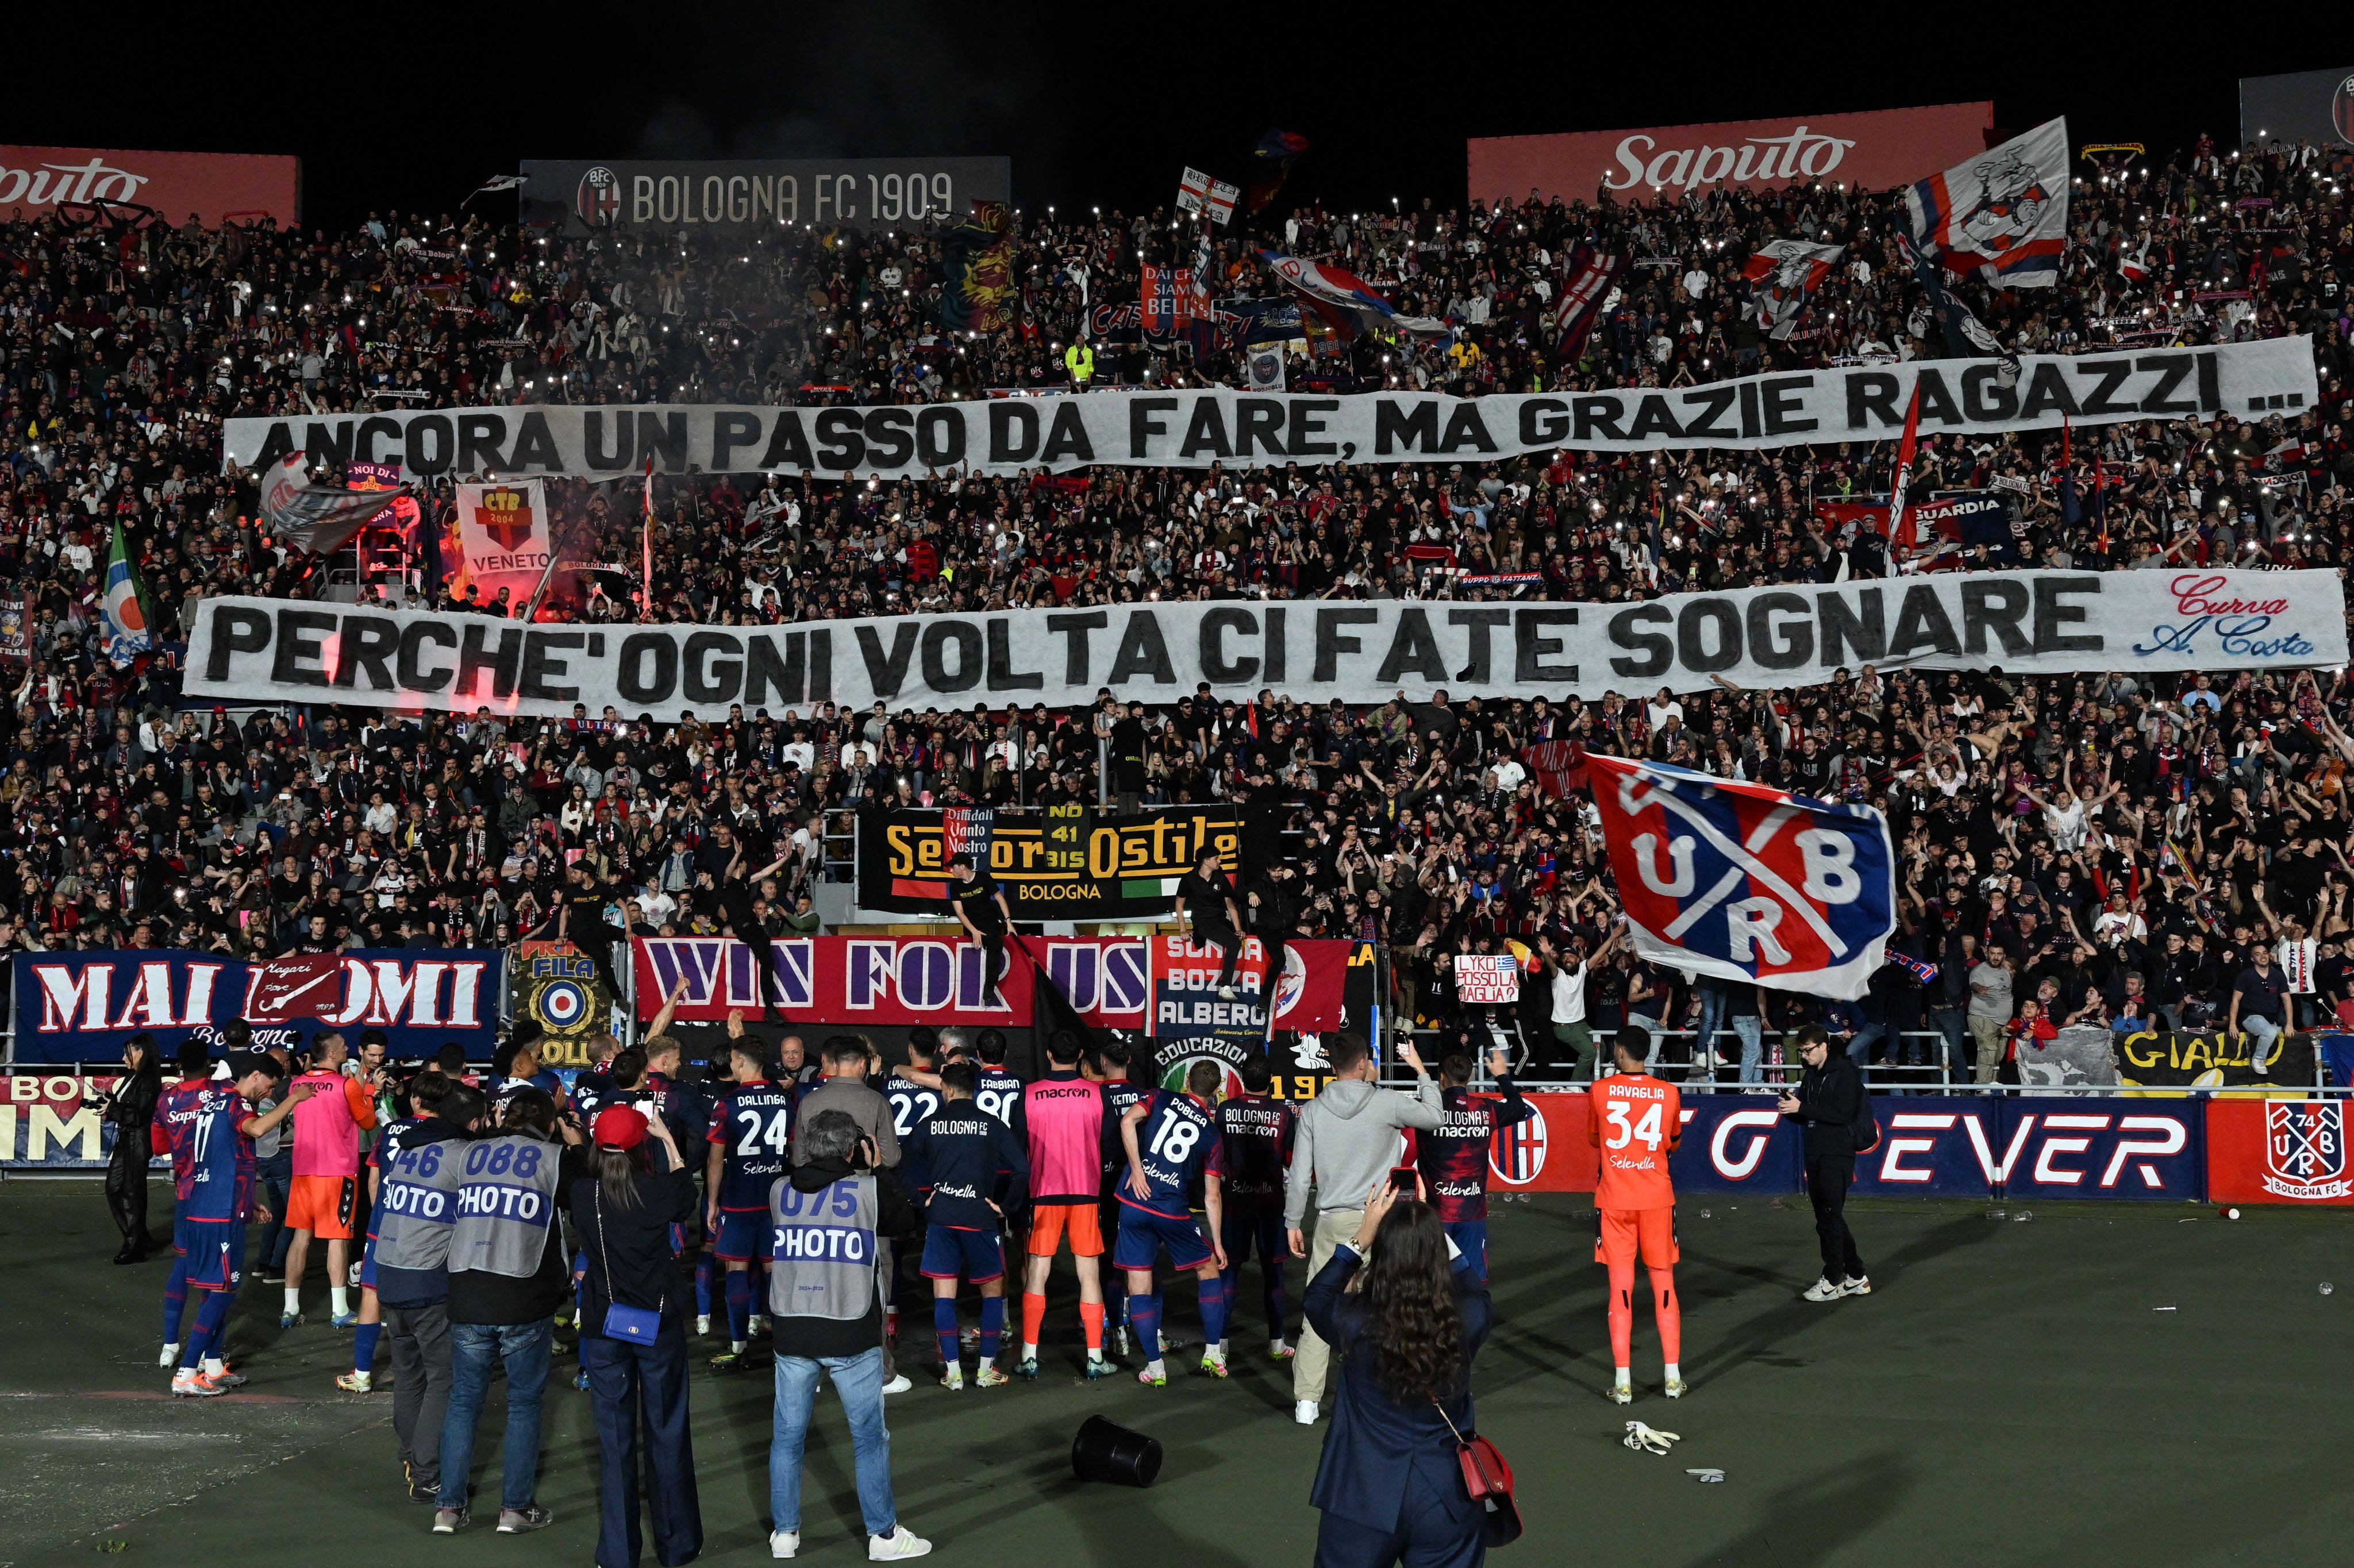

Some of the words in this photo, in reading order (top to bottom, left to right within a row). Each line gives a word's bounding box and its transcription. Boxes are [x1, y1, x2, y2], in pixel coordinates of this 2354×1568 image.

[1607, 126, 1856, 192] Saputo
[590, 169, 610, 183] BFC
[633, 175, 798, 224] BOLOGNA
[814, 174, 856, 221] FC
[867, 172, 952, 221] 1909
[1145, 267, 1171, 280] DAI
[1153, 283, 1191, 296] SIAM
[1148, 298, 1192, 316] BELL
[1314, 340, 1340, 354] 1991
[253, 413, 566, 475] ANCORA
[584, 410, 687, 472] UN
[711, 407, 966, 470] PASSO
[989, 400, 1095, 463] DA
[1130, 396, 1357, 460] FARE,
[1375, 399, 1498, 454] MA
[1518, 375, 1819, 445] GRAZIE
[1845, 351, 2222, 429] RAGAZZI
[353, 465, 375, 476] NOI
[376, 467, 390, 479] DI
[1999, 476, 2023, 491] BOLOGNA
[2023, 483, 2030, 492] FC
[484, 492, 520, 511] CTB
[1915, 499, 2001, 520] GUARDIA
[490, 513, 514, 523] 2004
[472, 552, 550, 573] VENETO
[568, 561, 611, 571] BOLOGNA
[2171, 575, 2289, 615] Curva
[617, 628, 831, 707] OGNI
[855, 610, 1176, 696] VOLTA
[1199, 607, 1286, 684] CI
[1313, 607, 1579, 683] FATE
[1609, 577, 2104, 677] SOGNARE
[2215, 615, 2315, 658] Costa
[0, 646, 28, 657] TRAS
[1049, 806, 1083, 818] NO
[1051, 826, 1078, 842] 41
[947, 835, 987, 853] Nostro
[1089, 816, 1238, 879] Ostile
[1019, 884, 1101, 901] BOLOGNA
[521, 939, 590, 961] PRIM
[264, 962, 312, 978] Magari
[532, 956, 595, 980] FILA
[1459, 956, 1496, 971] LYKO
[642, 937, 814, 1008] WIN
[1047, 942, 1146, 1014] US
[1456, 972, 1498, 987] POSSO
[1499, 971, 1517, 987] LA
[32, 959, 224, 1033] MAI
[189, 1026, 297, 1054] Bogna
[980, 1078, 1020, 1089] FABBIAN
[1608, 1083, 1666, 1101] RAVAGLIA
[198, 1089, 214, 1101] BFC
[737, 1093, 786, 1107] DALLINGA
[1034, 1088, 1091, 1100] macron
[167, 1110, 202, 1124] Sapu
[889, 1092, 938, 1136] 22
[1170, 1097, 1207, 1128] POBEGA
[1225, 1108, 1271, 1125] BOLOGNA
[1272, 1111, 1280, 1121] FC
[1443, 1109, 1482, 1126] OLOGNA
[1482, 1110, 1490, 1120] FC
[2295, 1114, 2316, 1128] 74
[736, 1109, 787, 1156] 24
[930, 1120, 978, 1135] BOLOGNA
[979, 1121, 988, 1130] FC
[1225, 1123, 1279, 1138] macron
[1433, 1126, 1490, 1138] macron
[1605, 1100, 1663, 1151] 34
[1149, 1107, 1200, 1164] 18
[2319, 1130, 2336, 1154] B
[2274, 1134, 2291, 1156] U
[392, 1143, 444, 1178] 46
[466, 1142, 543, 1179] 088
[743, 1159, 783, 1175] Selenella
[1609, 1154, 1656, 1170] Selenella
[2297, 1151, 2315, 1175] R
[1141, 1158, 1180, 1189] Selenella
[1434, 1181, 1481, 1197] Selenella
[2275, 1181, 2322, 1196] BOLOGNA
[2326, 1184, 2338, 1195] FC
[385, 1184, 445, 1218] HOTO
[457, 1185, 540, 1220] PHOTO
[780, 1180, 859, 1218] 075
[774, 1228, 864, 1260] PHOTO
